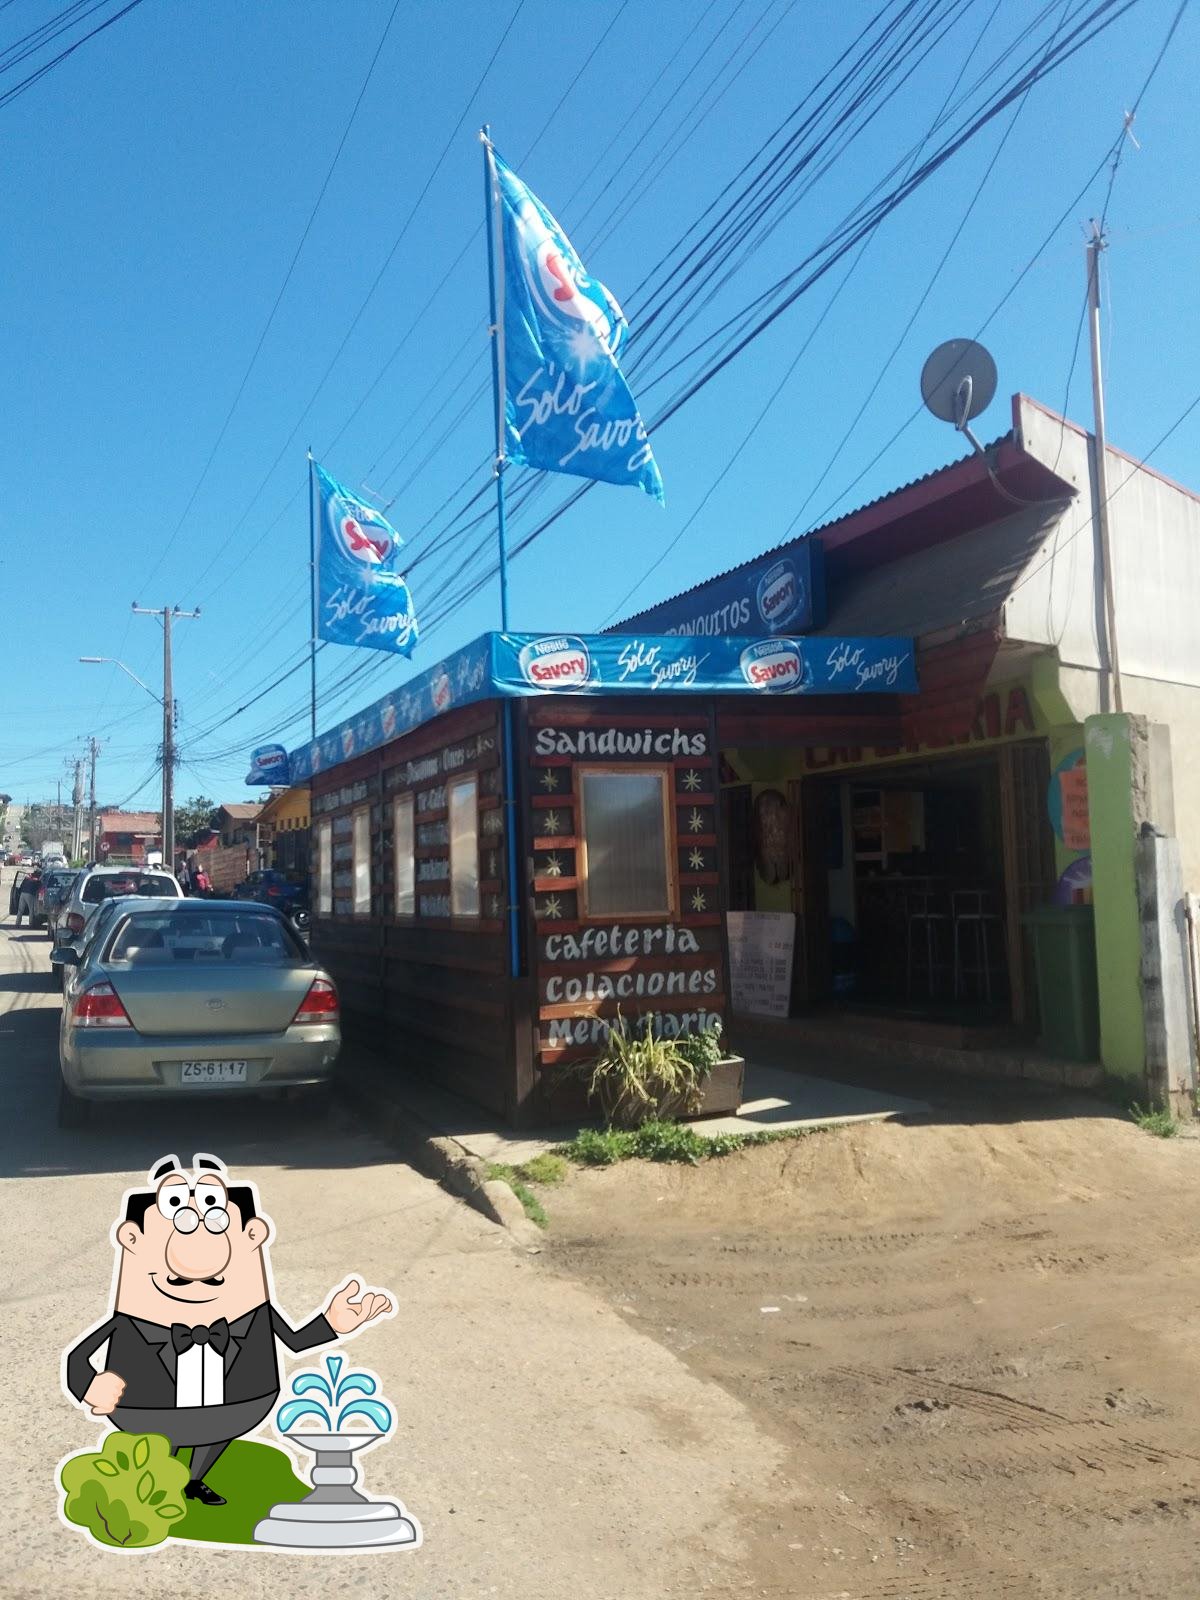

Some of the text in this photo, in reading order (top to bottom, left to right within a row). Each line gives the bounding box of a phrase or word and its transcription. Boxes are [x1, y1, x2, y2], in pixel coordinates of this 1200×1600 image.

[531, 657, 585, 681] Savory
[618, 640, 661, 681] Sólo
[650, 652, 711, 690] Savory
[750, 658, 798, 684] Savory
[856, 653, 909, 690] Savory
[535, 728, 706, 755] Sandwichs
[545, 924, 700, 960] Cafeteria
[546, 969, 716, 1002] Colaciones
